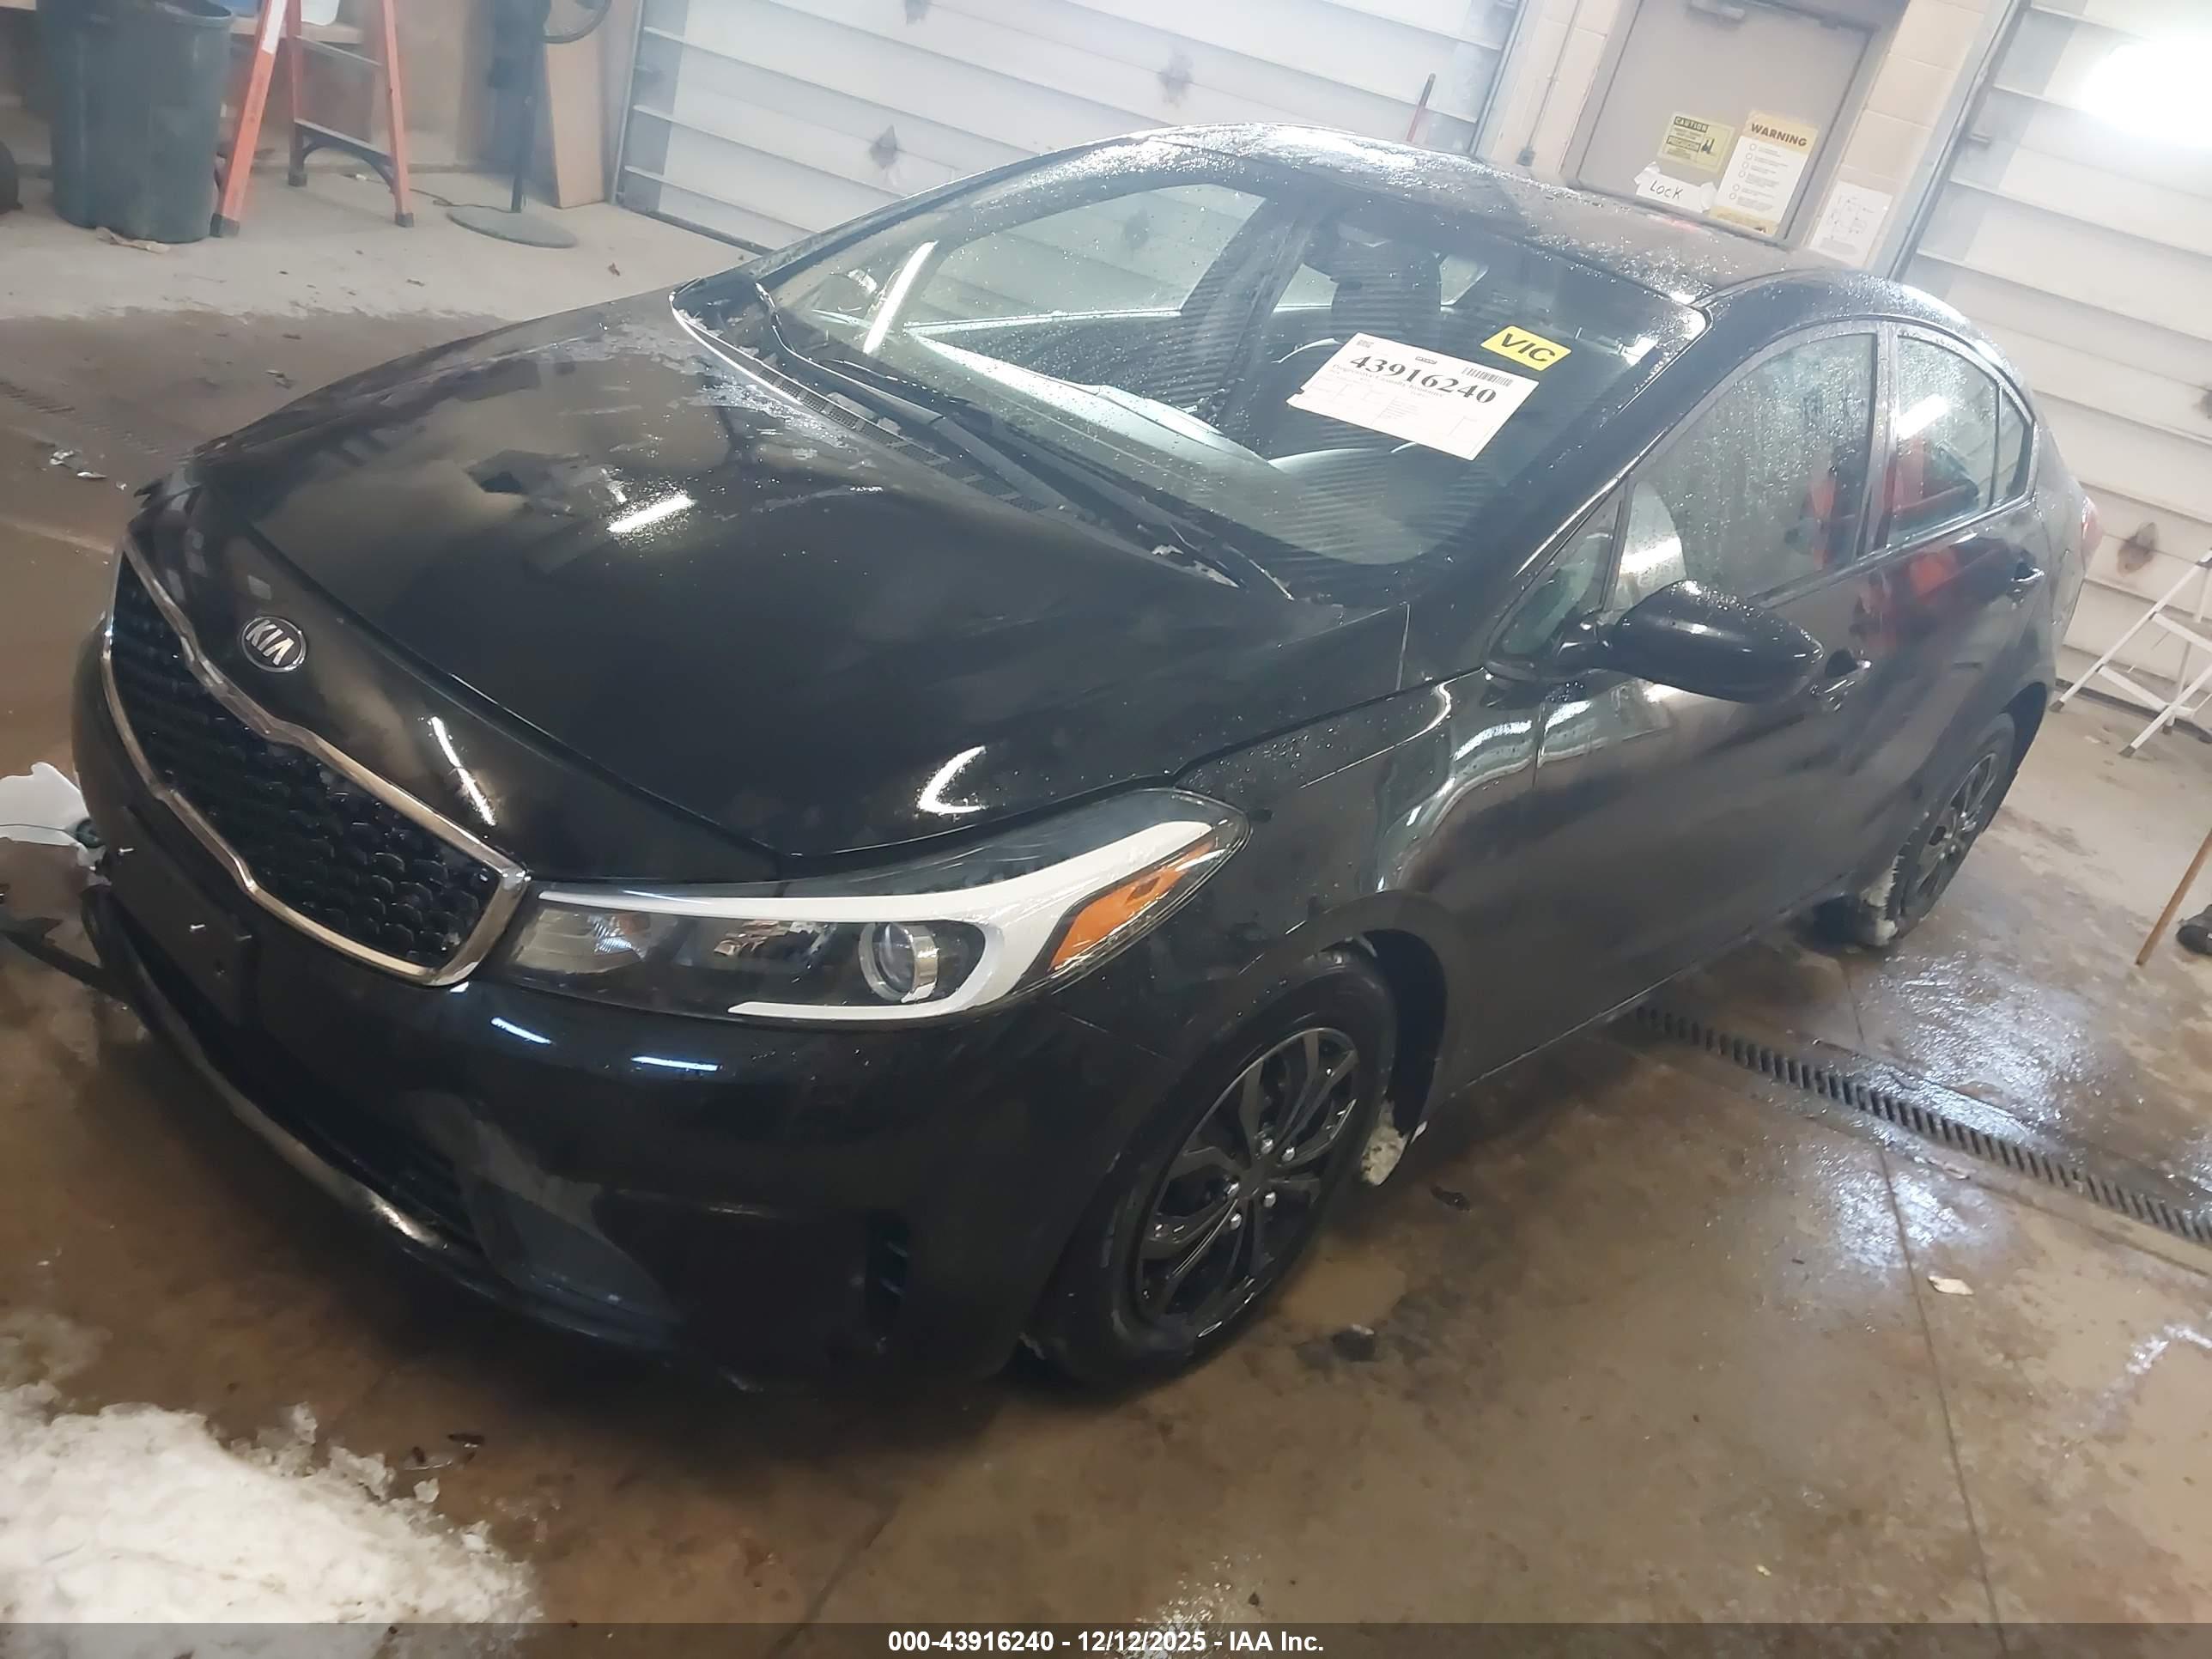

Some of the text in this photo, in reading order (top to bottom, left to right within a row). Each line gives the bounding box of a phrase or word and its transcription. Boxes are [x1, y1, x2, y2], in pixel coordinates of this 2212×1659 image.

[1675, 117, 1707, 131] CAUTION
[1751, 124, 1808, 147] WARNING
[1501, 332, 1555, 362] VIC
[1350, 356, 1496, 403] 43916240
[246, 619, 295, 665] KIA
